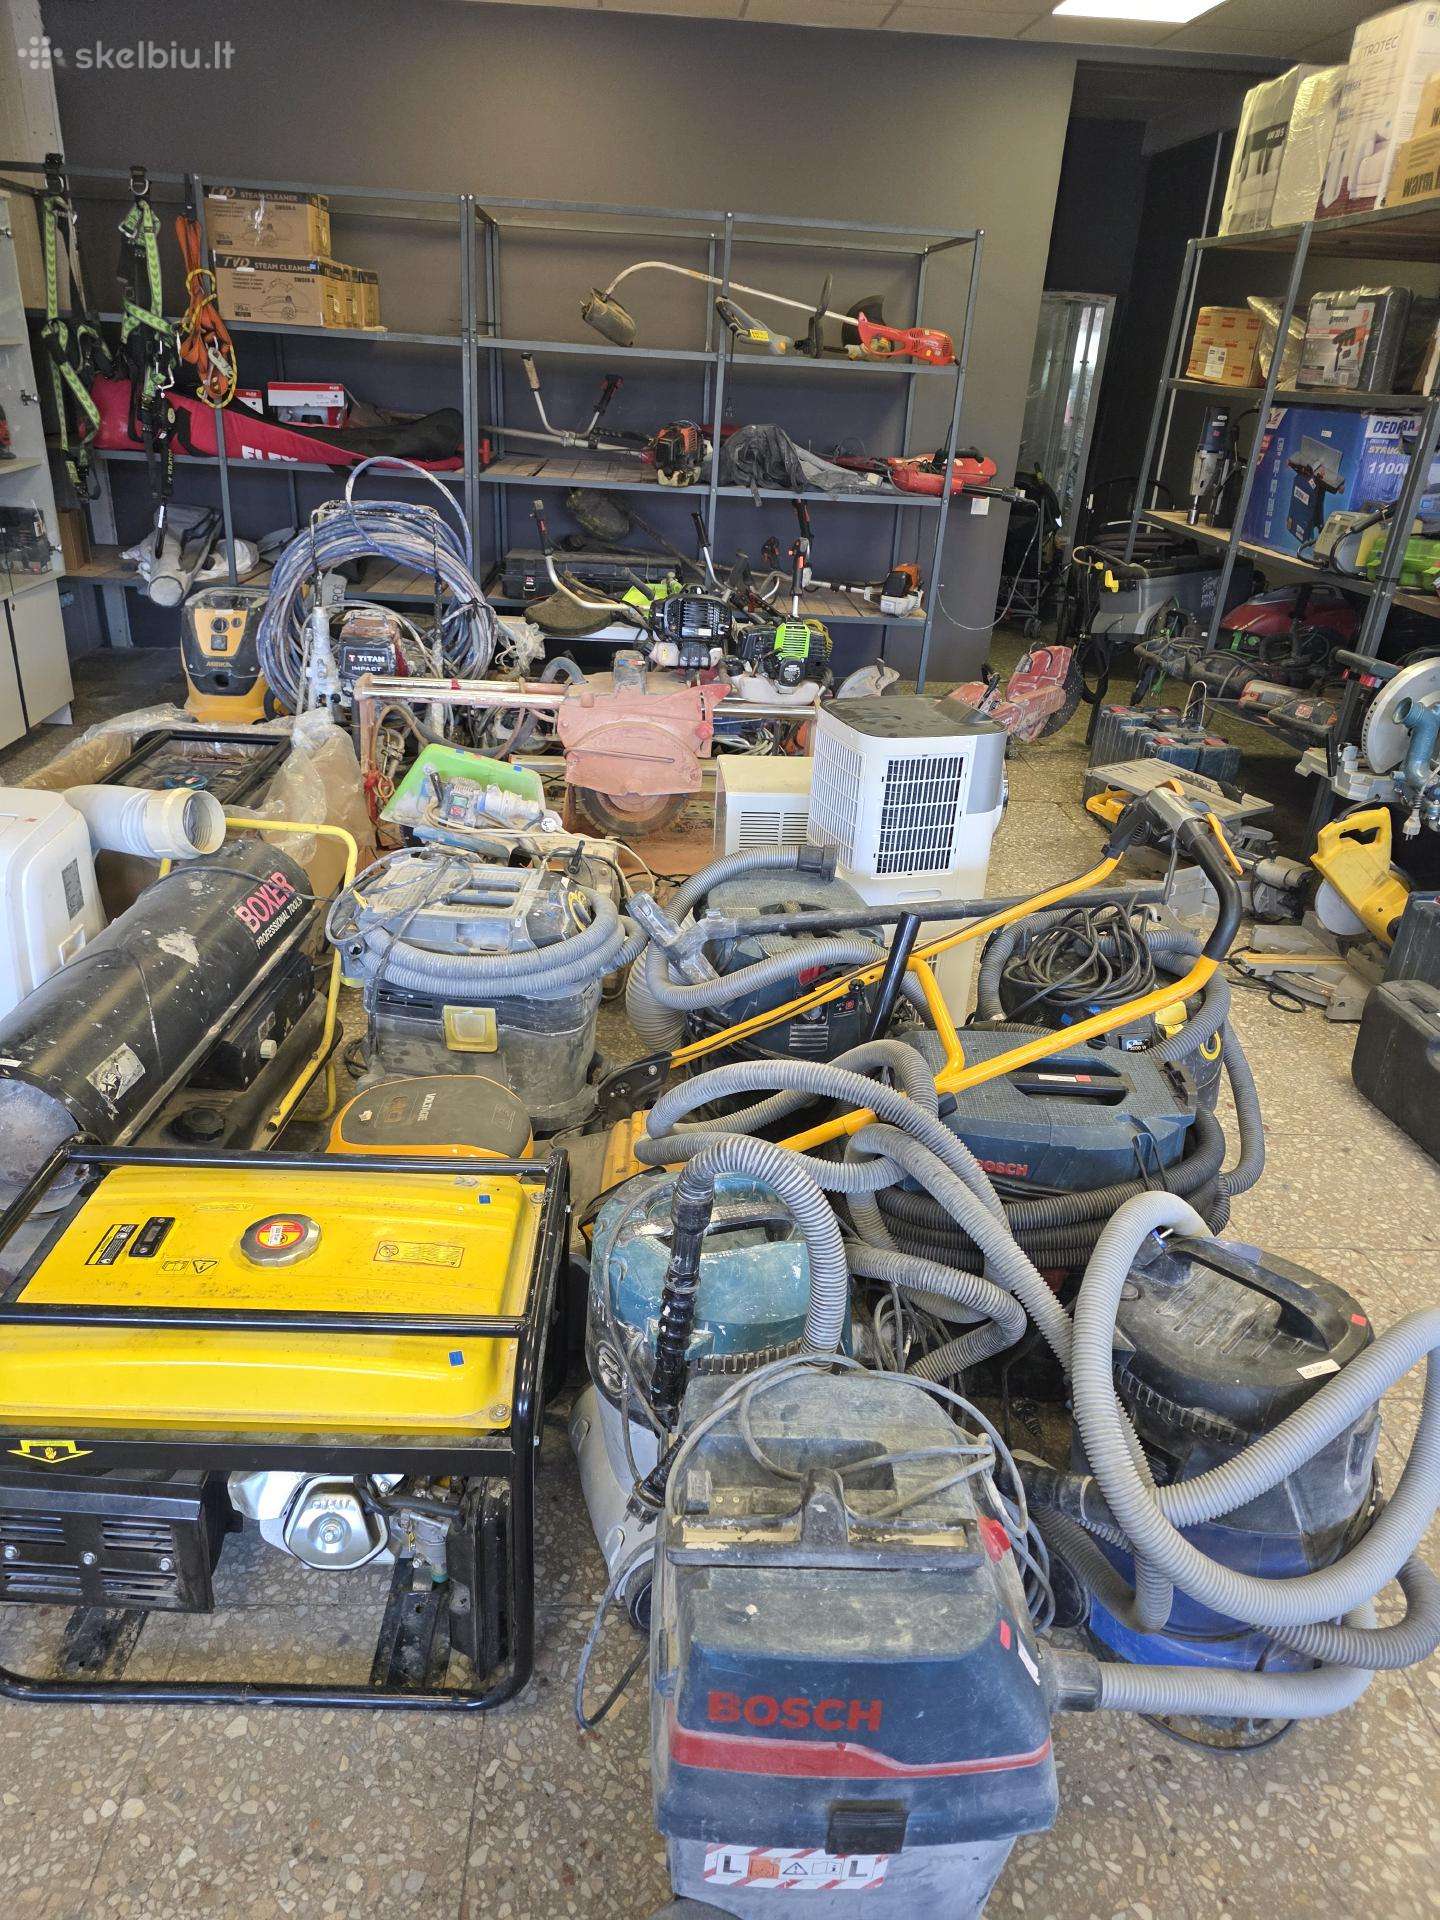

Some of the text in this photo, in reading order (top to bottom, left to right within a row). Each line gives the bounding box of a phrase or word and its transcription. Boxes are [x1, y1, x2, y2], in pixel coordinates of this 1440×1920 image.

[254, 262, 278, 271] STEAM
[356, 655, 386, 663] TITAN
[233, 871, 296, 935] BOXER
[255, 896, 304, 950] PROFESSIONAL TOOLS
[707, 1690, 883, 1732] BOSCH
[722, 1855, 868, 1877] L L
